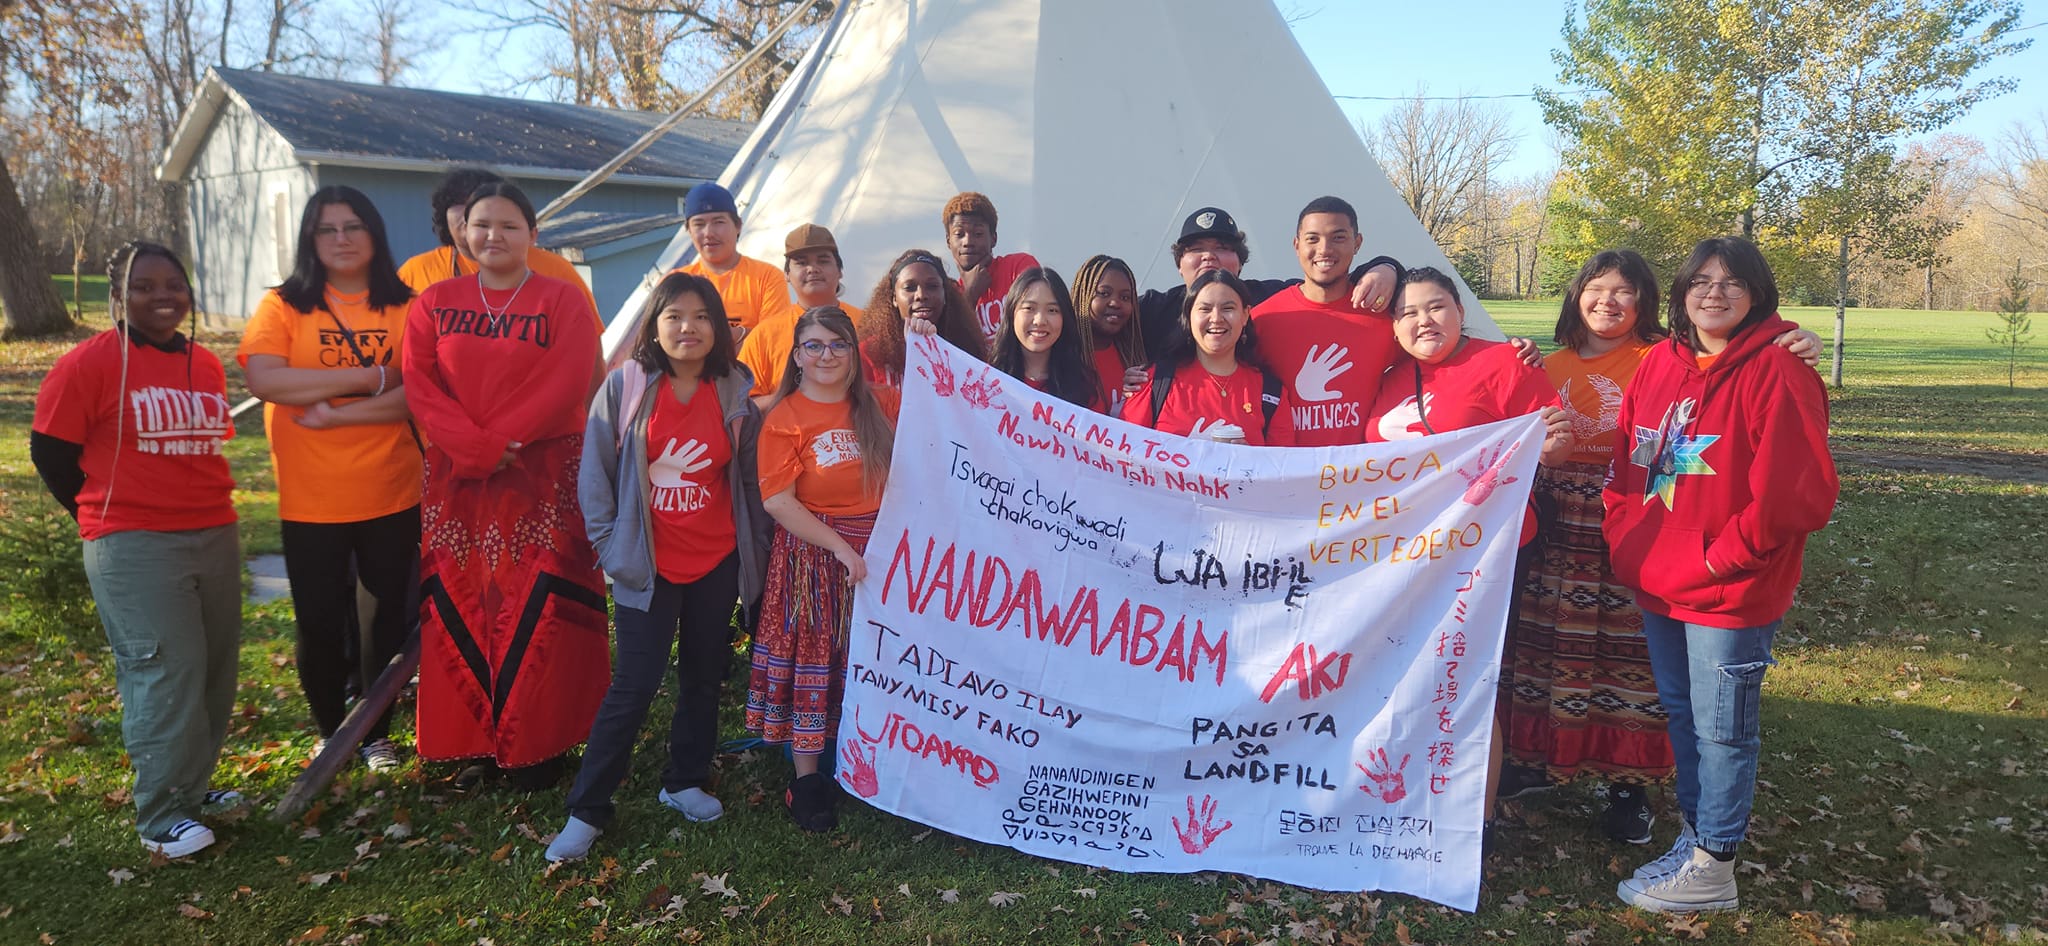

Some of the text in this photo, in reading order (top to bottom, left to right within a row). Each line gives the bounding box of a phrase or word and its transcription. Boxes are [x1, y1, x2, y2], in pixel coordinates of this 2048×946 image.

[320, 334, 386, 347] EVRY
[1291, 402, 1360, 431] MMIWG2S
[138, 439, 159, 454] NO
[831, 432, 860, 443] EVER
[998, 411, 1065, 458] Nawh
[1073, 447, 1114, 473] Wah
[1117, 459, 1155, 487] Tah
[1033, 401, 1190, 468] Nah Nah Too
[1320, 451, 1442, 490] BUSCA
[1319, 496, 1412, 529] EN EL
[1309, 522, 1483, 565] VERTEDERO
[882, 528, 1352, 704] NANDAWAABAM AKI
[868, 619, 1082, 728] TADIAVO ILAY
[977, 711, 1040, 748] FAKO
[1232, 741, 1270, 759] SA
[1028, 765, 1156, 790] NANANDINIGEN
[1184, 759, 1337, 792] LANDFILL
[1018, 796, 1134, 825] GEHNANDOK
[1349, 842, 1363, 856] LA
